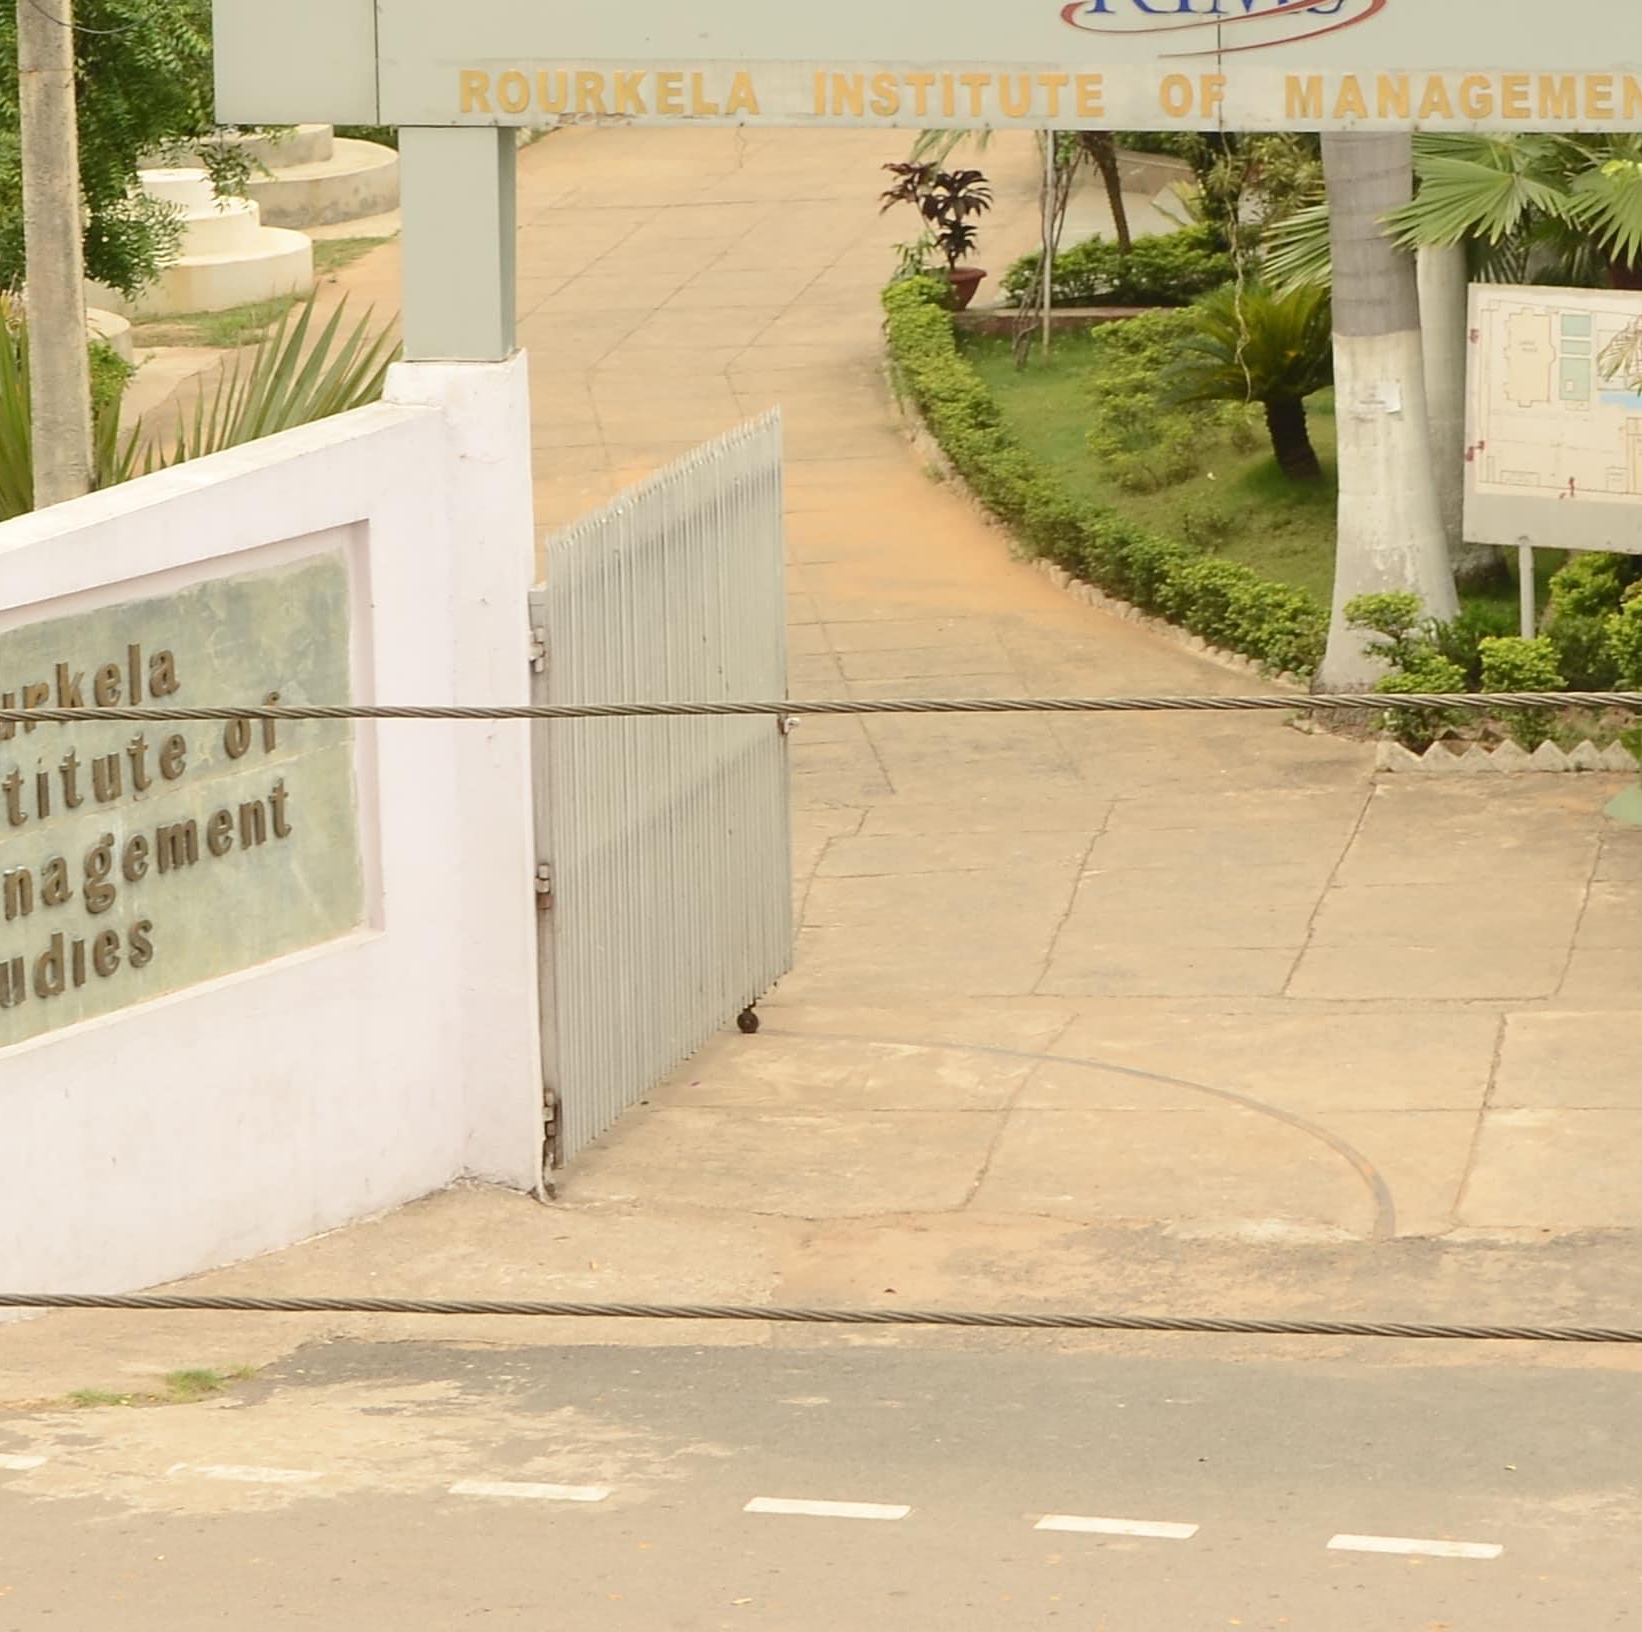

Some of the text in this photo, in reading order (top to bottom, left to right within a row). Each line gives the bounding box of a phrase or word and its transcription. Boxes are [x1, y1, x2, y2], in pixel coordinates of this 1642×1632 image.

[458, 69, 760, 117] ROURKELA
[813, 71, 1105, 120] INSTITUTE
[1158, 73, 1229, 121] OF
[222, 689, 283, 760] of
